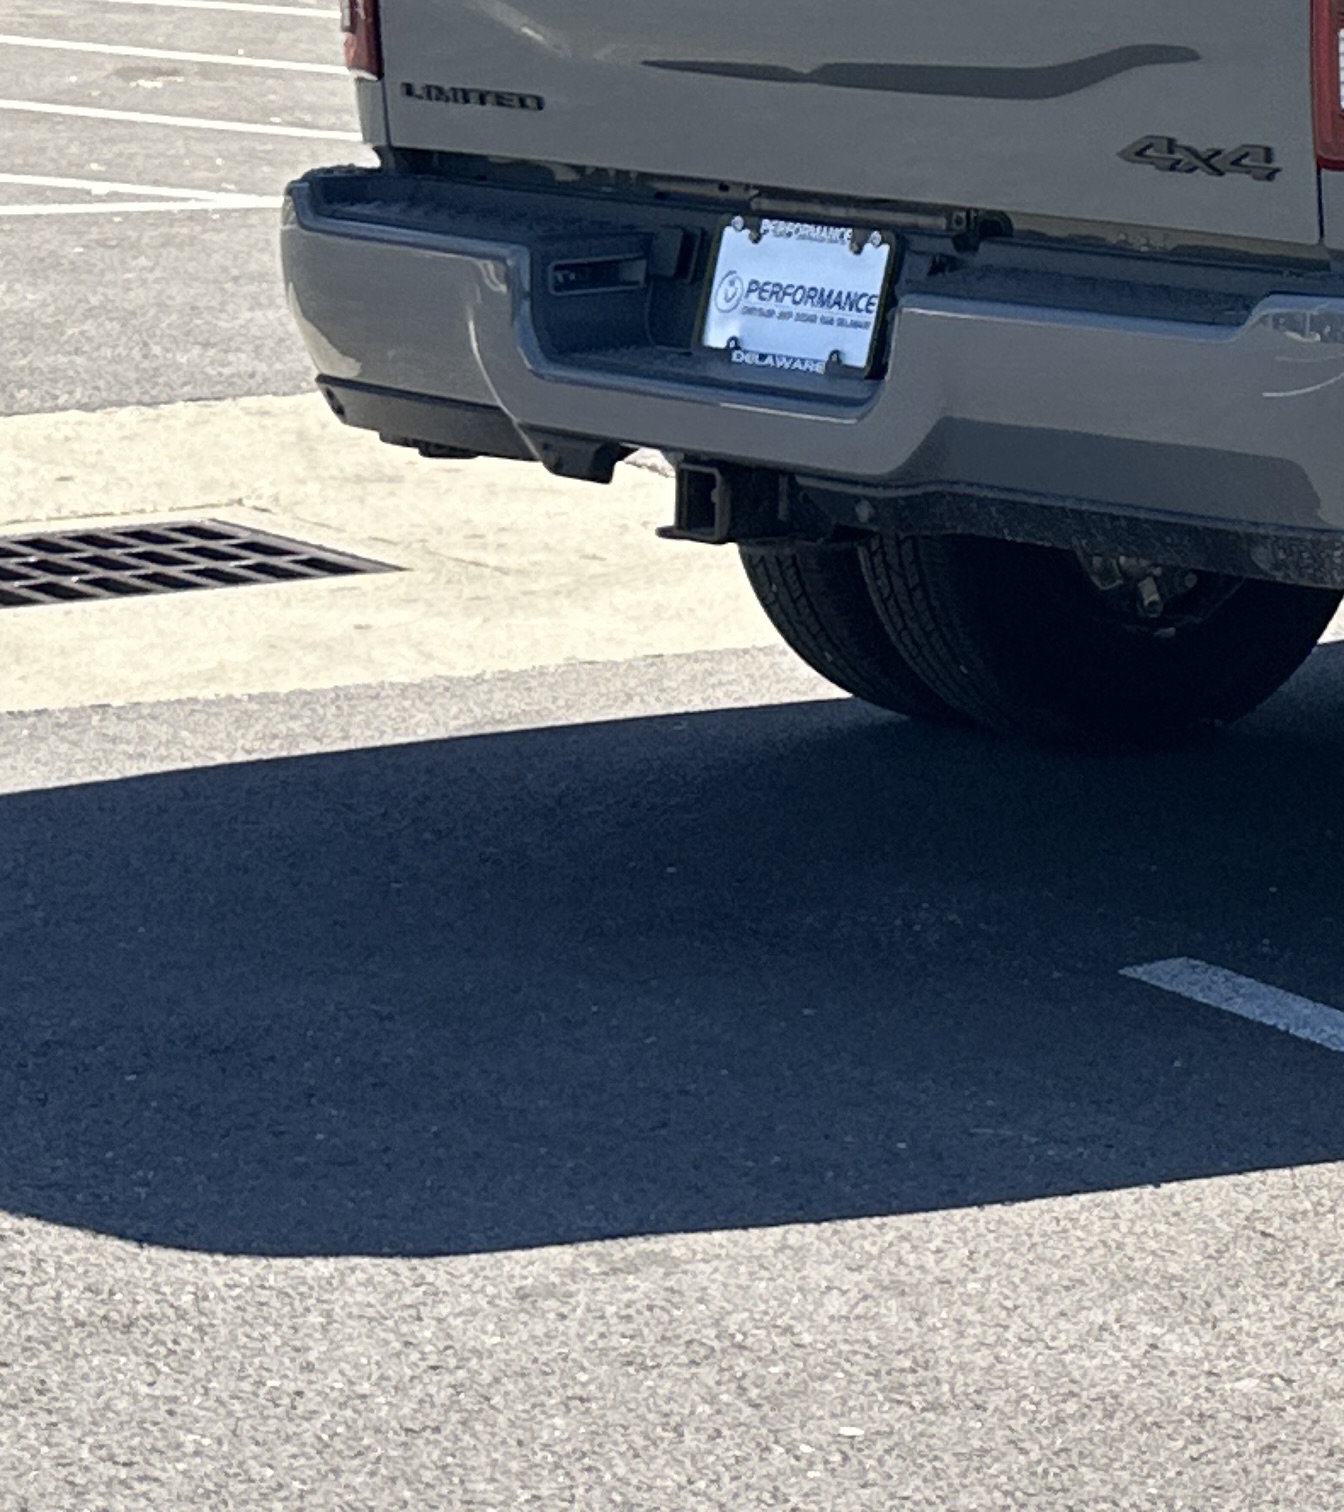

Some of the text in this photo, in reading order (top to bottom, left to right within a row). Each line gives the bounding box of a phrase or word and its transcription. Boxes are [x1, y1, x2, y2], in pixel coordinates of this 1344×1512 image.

[400, 82, 545, 112] LIMITED
[1116, 134, 1283, 182] 4x4
[745, 279, 880, 313] PERFORMANCE
[731, 350, 826, 375] DELAWARE
